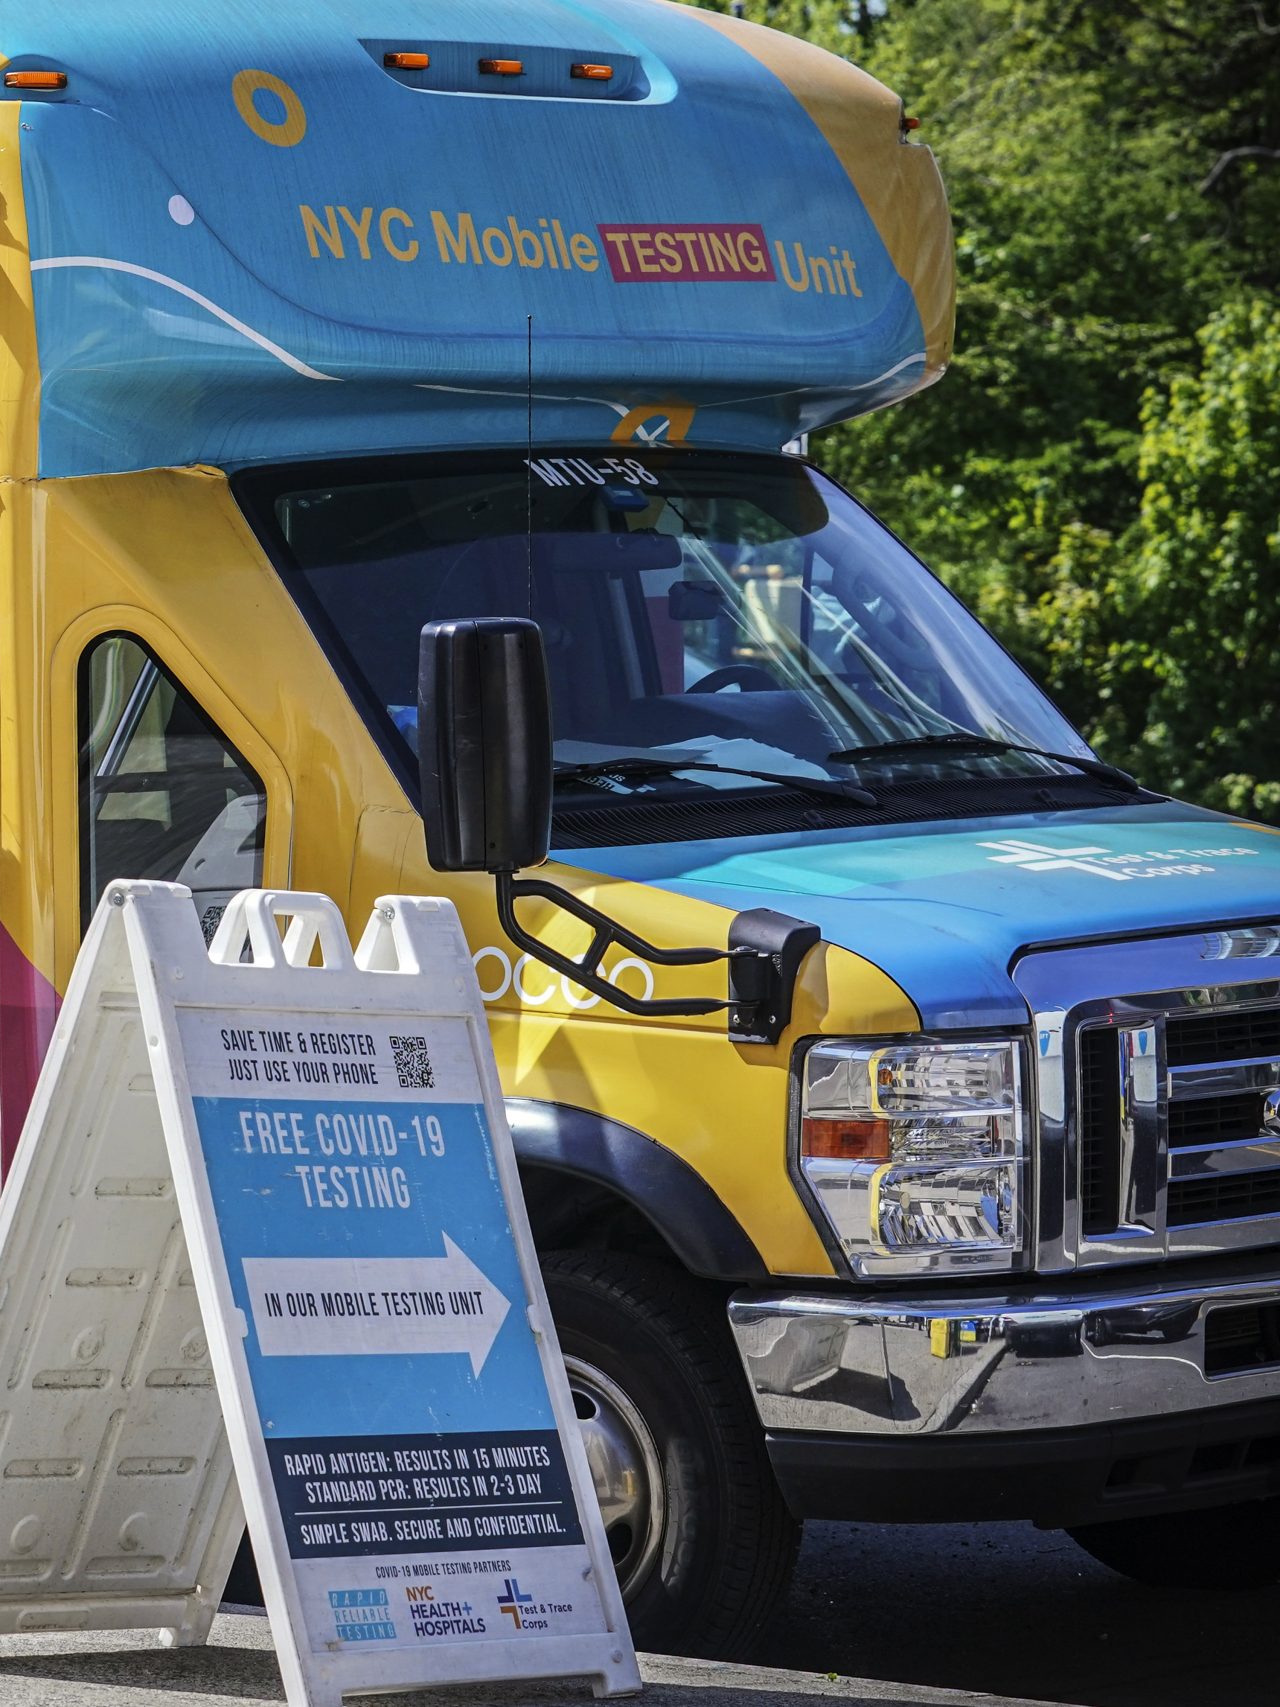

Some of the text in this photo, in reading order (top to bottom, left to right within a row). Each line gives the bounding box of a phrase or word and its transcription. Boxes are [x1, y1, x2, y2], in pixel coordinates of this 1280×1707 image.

[299, 204, 863, 298] NYC Mobile TESTING Unit
[522, 458, 659, 487] MTU-58
[1075, 853, 1155, 866] Test
[1121, 864, 1216, 878] Corps
[221, 1029, 377, 1056] SAVE TIME & REGISTER
[228, 1058, 379, 1085] JUST USE YOUR PHONE
[239, 1111, 446, 1157] FREE COVID-19
[295, 1165, 411, 1208] TESTING
[265, 1291, 484, 1317] IN OUR MOBILE TESTING UNIT
[284, 1446, 551, 1476] RAPID ANTIGEN: RESULTS IN 15 MINUTES
[305, 1473, 542, 1504] STANDARD PCR: RESULTS IN 2-3 DAY
[300, 1513, 567, 1546] SIMPLE SWAB. SECURE AND CONFIDENTIAL.
[375, 1560, 512, 1579] COVID-19 MOBILE TESTING PARTNERS
[332, 1590, 385, 1607] RAPID
[405, 1586, 434, 1602] NYC
[335, 1608, 391, 1623] RELIABLE
[518, 1602, 573, 1616] Test & Trace
[337, 1625, 395, 1640] TESTING
[414, 1617, 486, 1637] HOSPITALS
[522, 1618, 549, 1631] Corps
